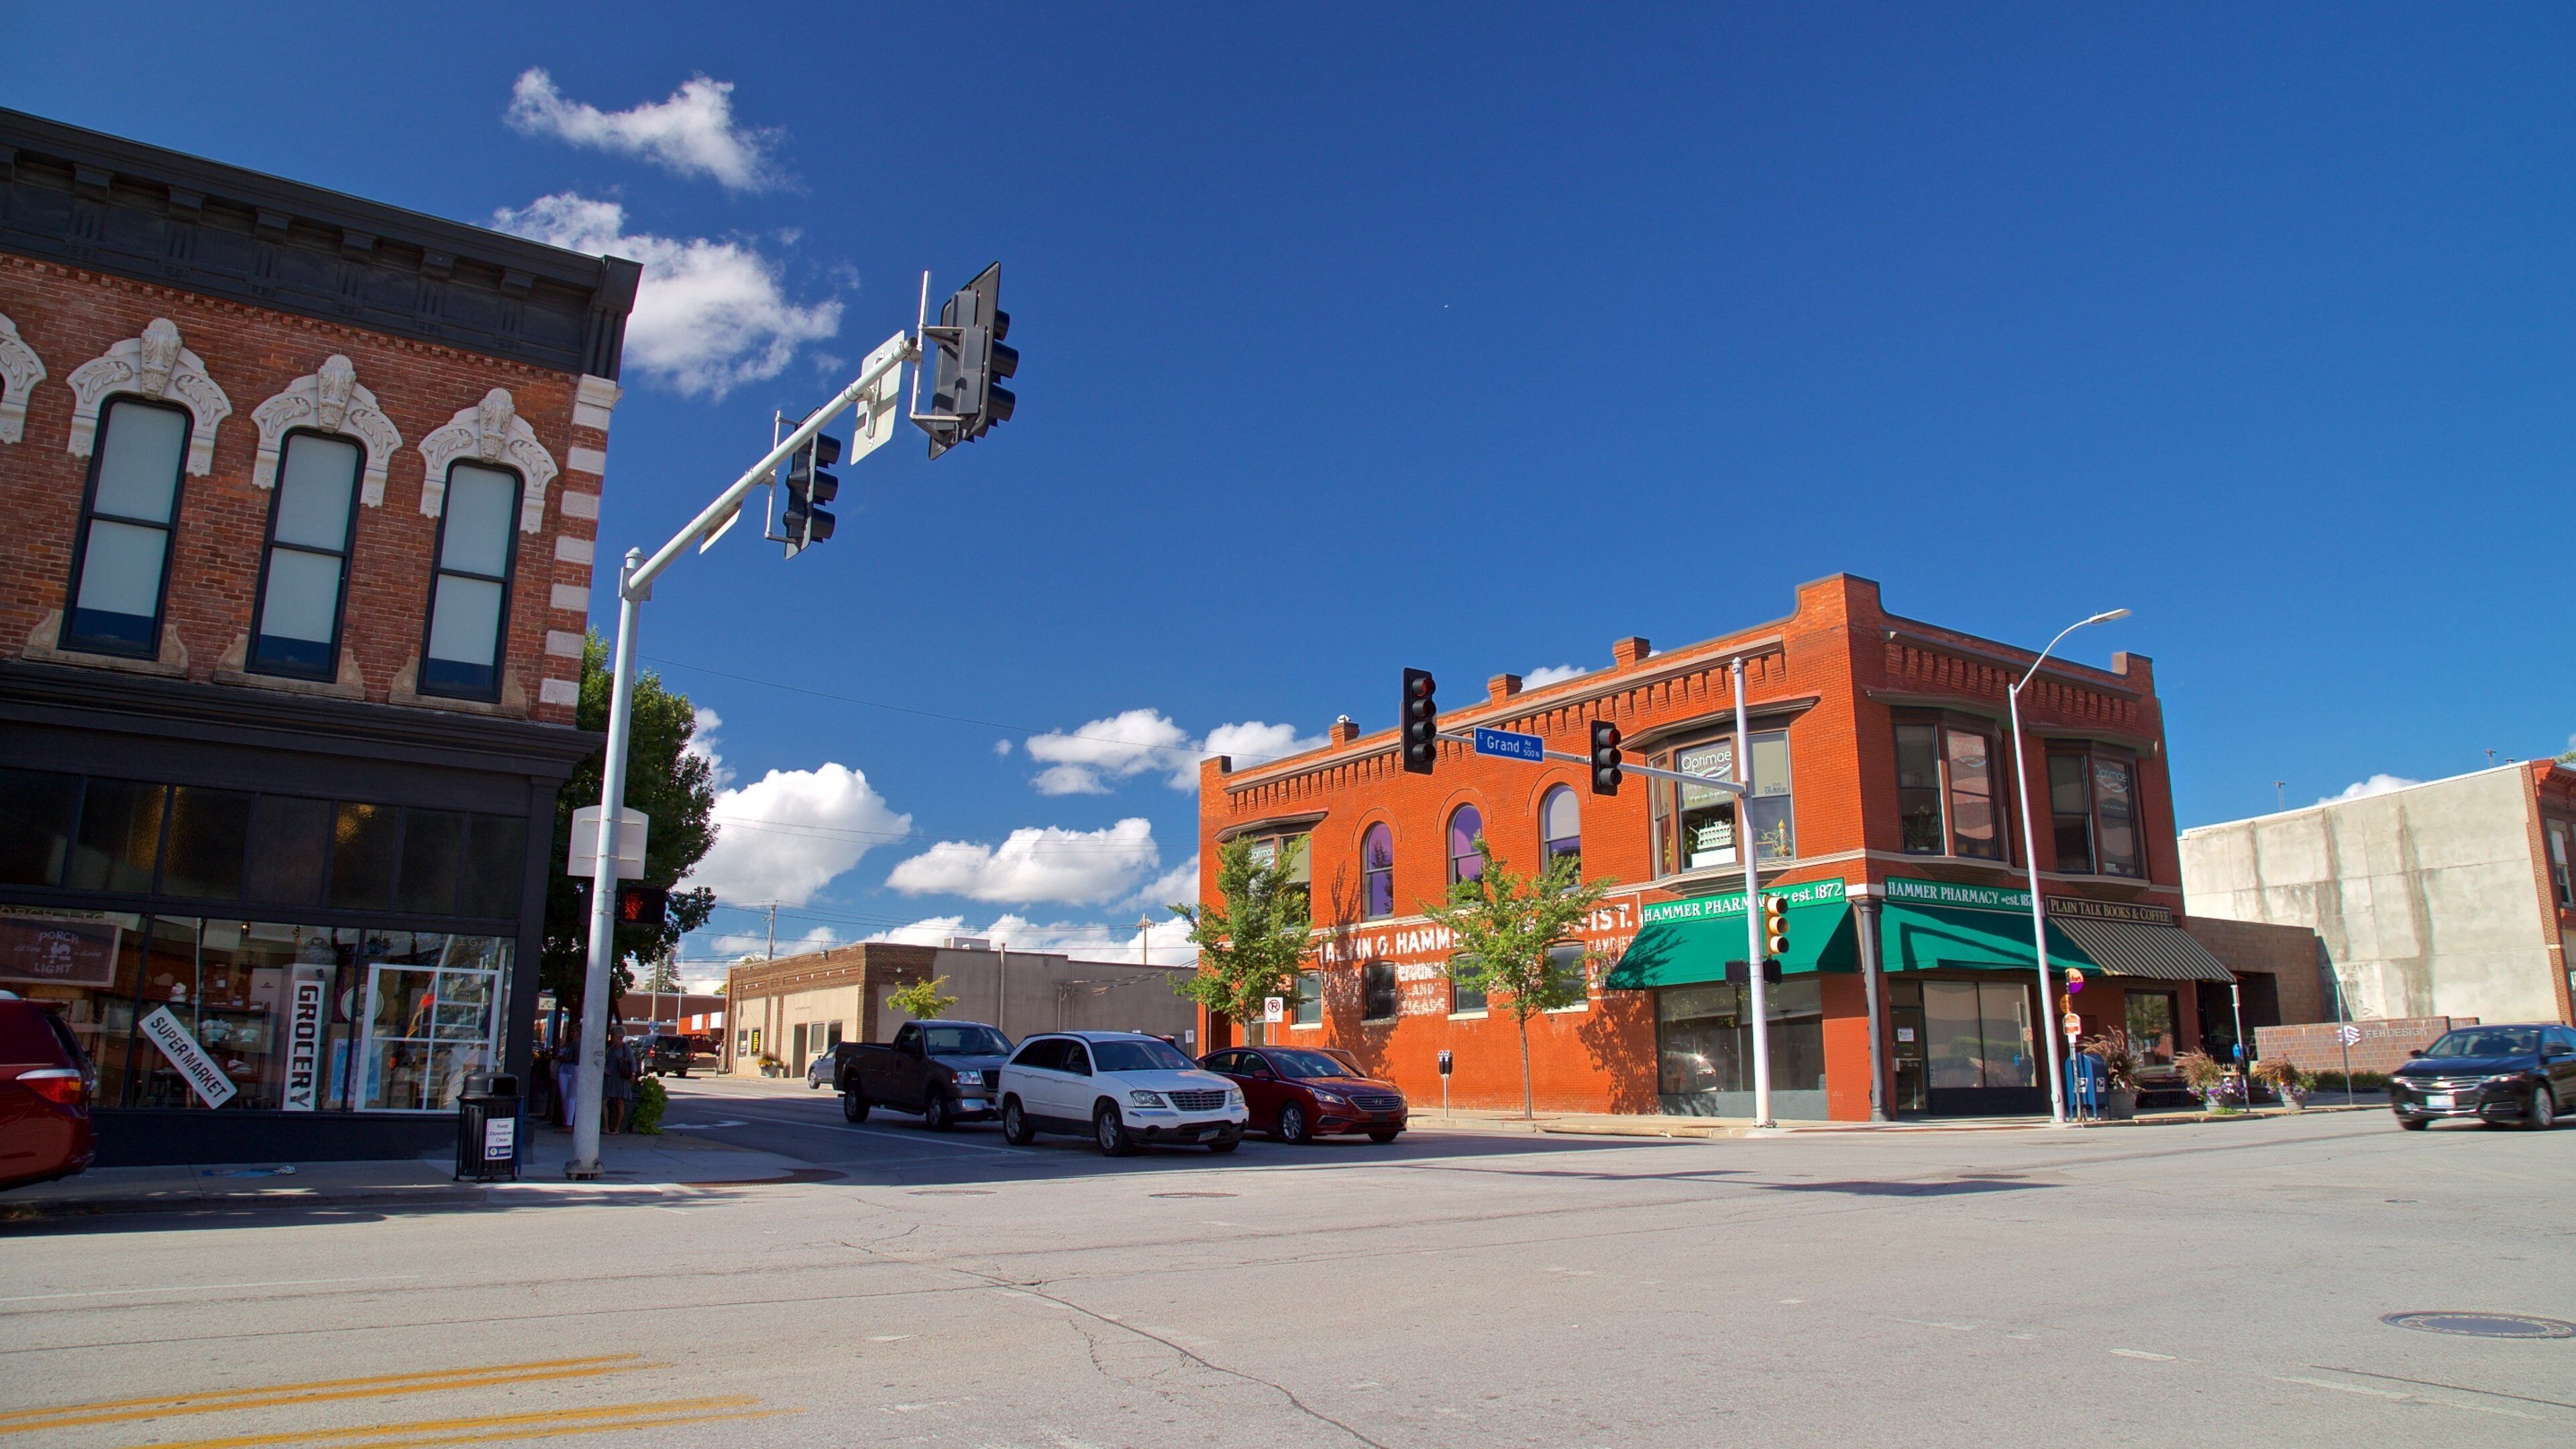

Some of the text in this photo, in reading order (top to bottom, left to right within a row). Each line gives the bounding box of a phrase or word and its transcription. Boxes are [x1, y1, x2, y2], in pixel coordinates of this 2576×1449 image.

[1487, 735, 1519, 753] Grand
[1682, 751, 1731, 771] Optimae
[1644, 903, 1701, 922] HAMMER
[1792, 890, 1813, 903] est.
[1815, 882, 1843, 900] 1872
[1888, 881, 1937, 900] HAMMER
[1941, 886, 1998, 905] PHARMACY
[2021, 894, 2033, 907] 187
[2050, 899, 2169, 922] PLAIN TALK BOOKS & COFFEE
[38, 930, 79, 944] PORCH
[35, 962, 73, 974] LIGHT
[290, 985, 319, 1108] GROCERY
